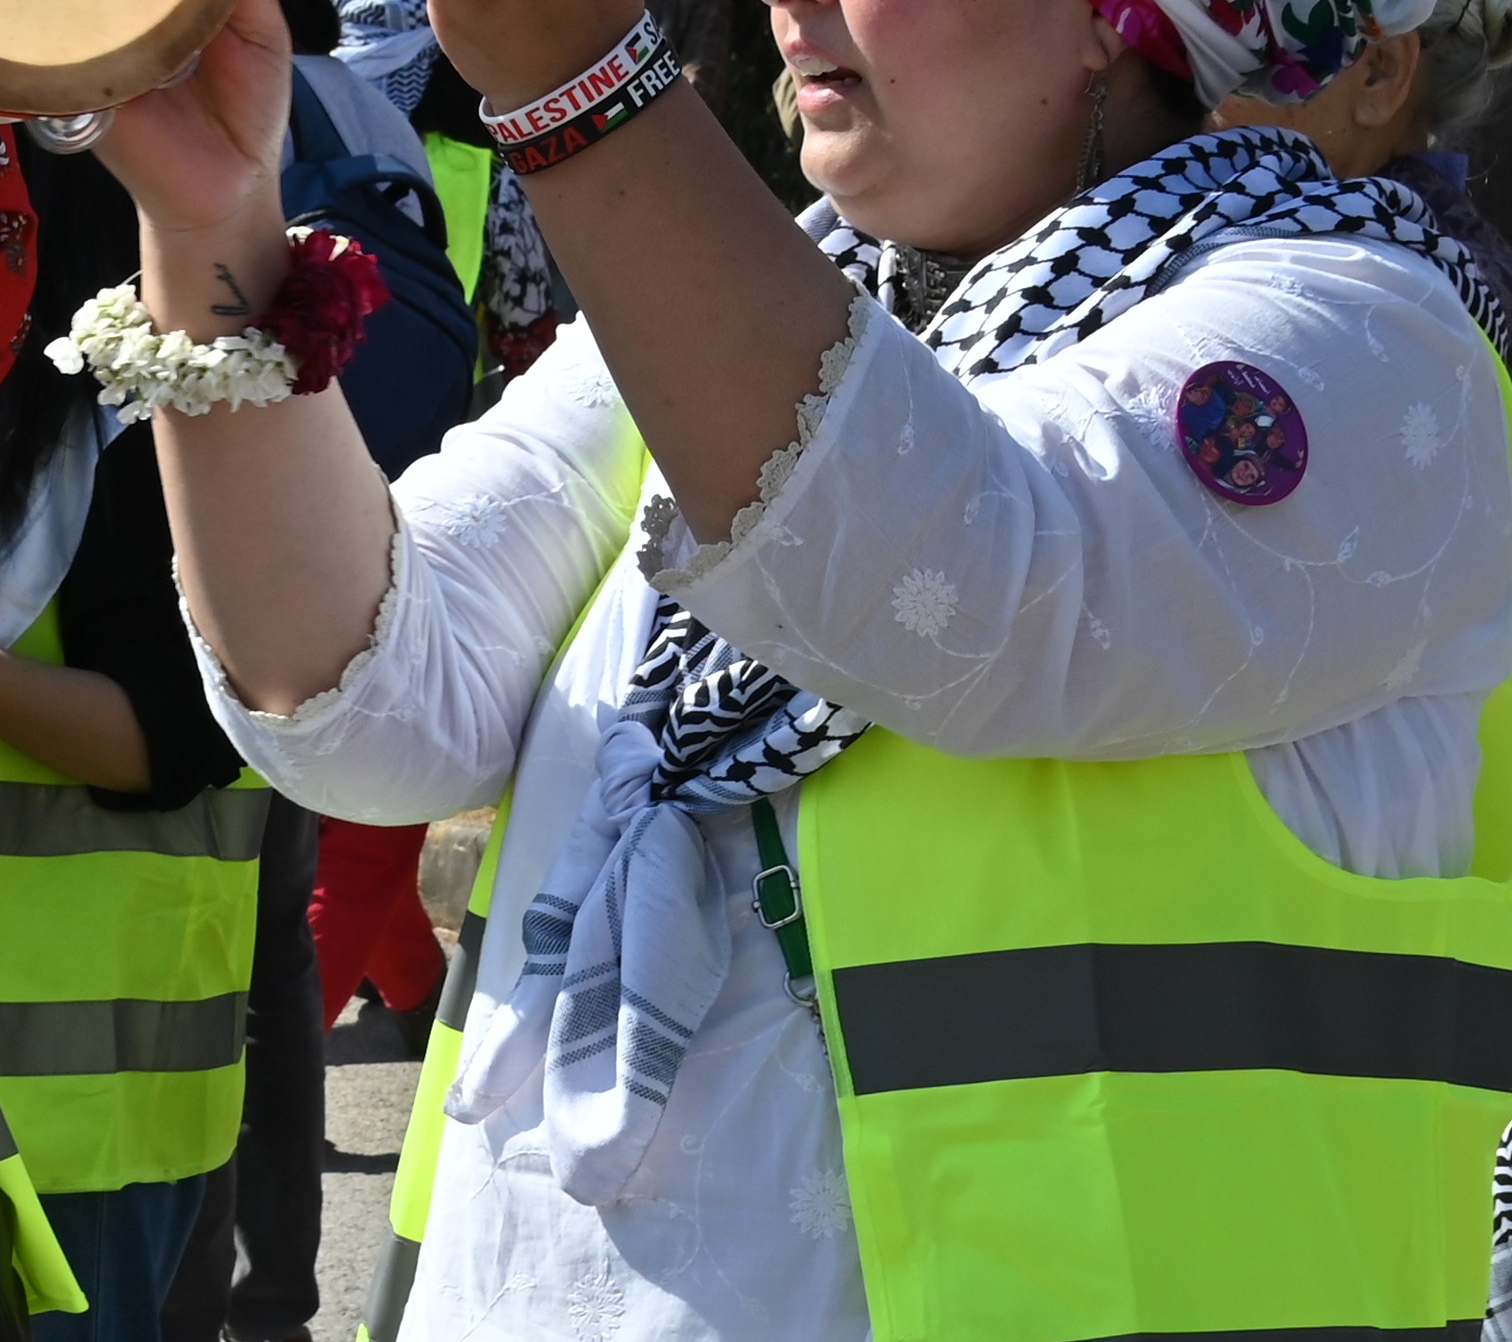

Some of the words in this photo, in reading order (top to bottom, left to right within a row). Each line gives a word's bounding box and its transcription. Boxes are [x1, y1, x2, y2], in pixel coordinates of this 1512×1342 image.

[487, 54, 630, 144] PALESTINE
[509, 125, 589, 175] GAZA
[627, 50, 681, 108] FREE
